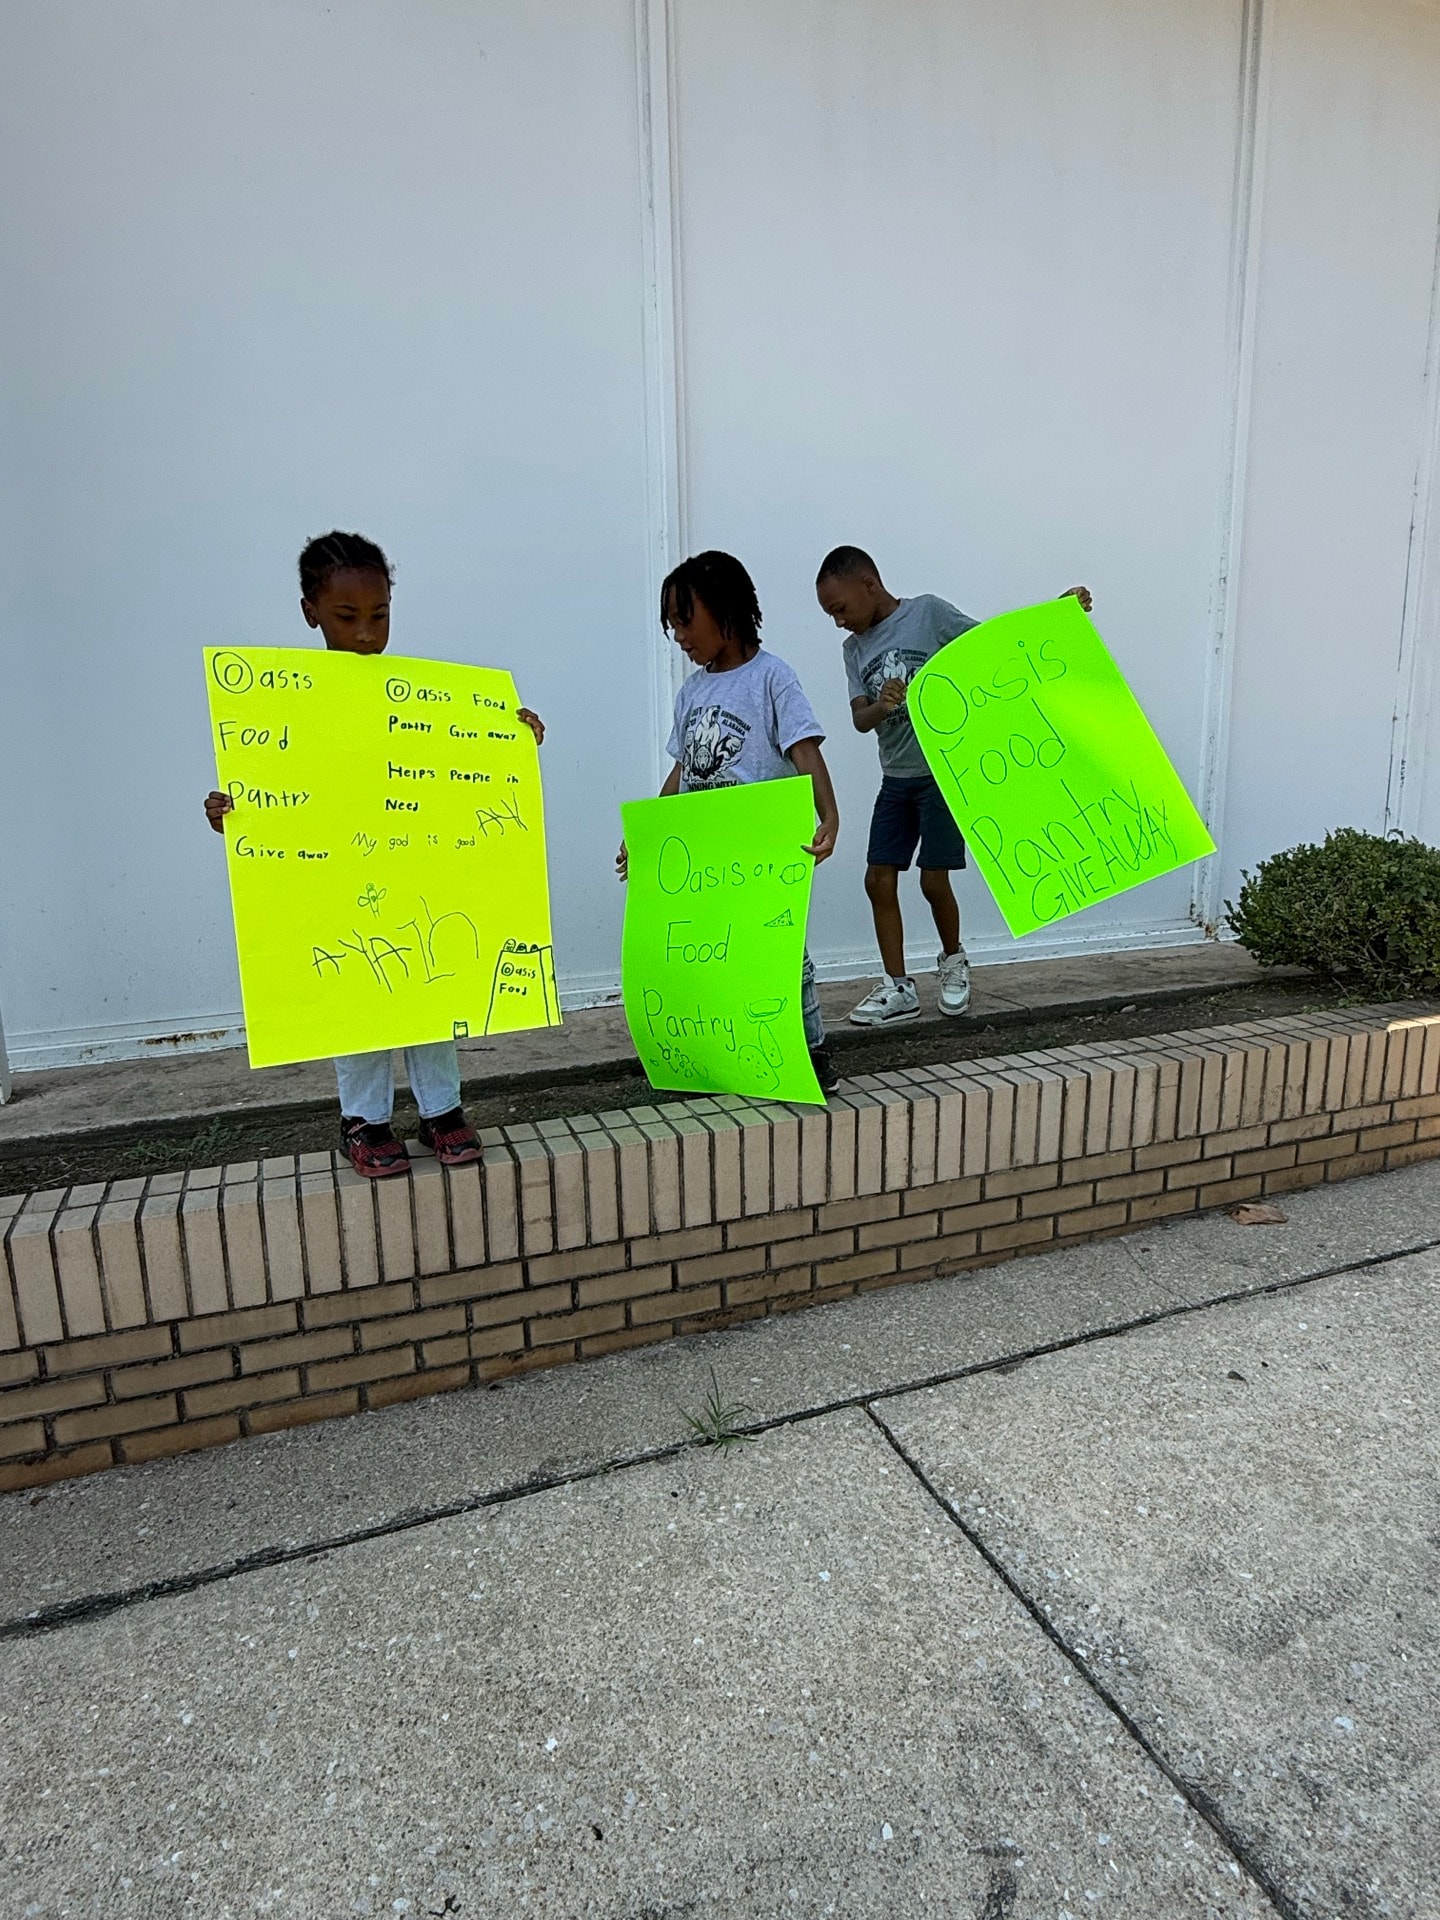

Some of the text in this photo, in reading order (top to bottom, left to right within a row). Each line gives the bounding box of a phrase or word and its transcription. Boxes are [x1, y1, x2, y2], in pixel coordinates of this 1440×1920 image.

[213, 652, 312, 694] Oasis
[918, 639, 1067, 734] Oasis
[386, 678, 505, 710] Oasis Food
[219, 721, 288, 751] Food
[389, 715, 516, 740] Pantry Give away
[939, 697, 1066, 806] Food
[507, 774, 518, 783] in
[228, 781, 310, 810] Pantry
[385, 799, 418, 812] Need
[236, 836, 328, 859] Give away
[351, 832, 475, 857] My god is good
[970, 779, 1142, 895] Pantry
[658, 836, 745, 894] Oasis
[667, 921, 731, 963] Food
[500, 962, 536, 979] Oasis
[499, 983, 527, 996] Food
[643, 987, 735, 1051] Pantry
